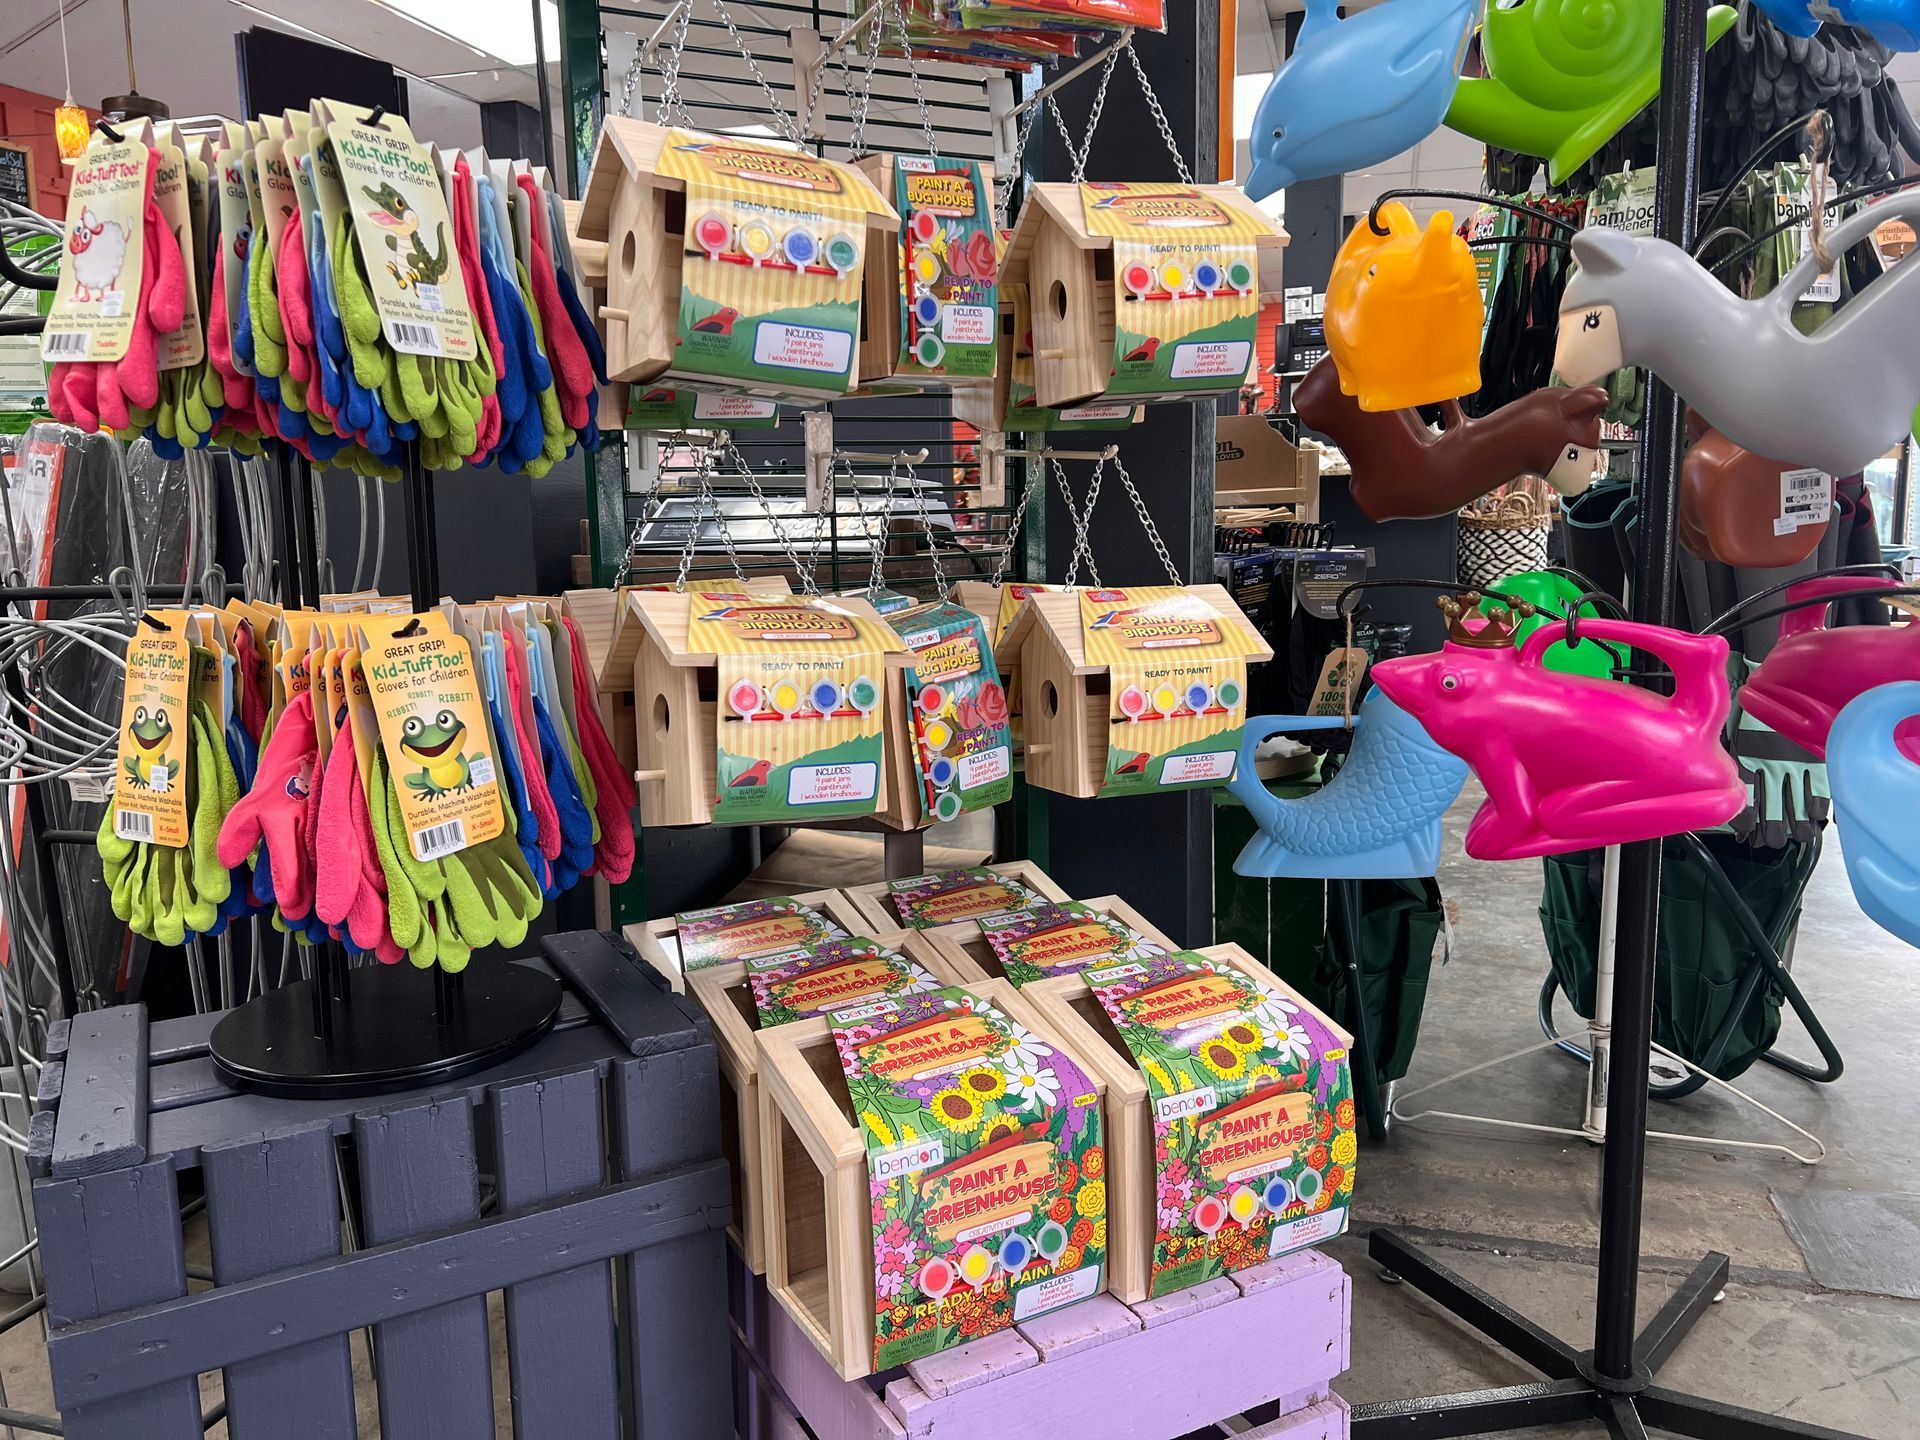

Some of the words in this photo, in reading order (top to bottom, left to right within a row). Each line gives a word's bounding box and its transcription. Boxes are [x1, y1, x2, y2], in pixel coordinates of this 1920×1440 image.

[351, 129, 382, 148] GREAT
[385, 138, 412, 154] GRIP!
[338, 139, 402, 168] Kid-Tuff
[402, 154, 430, 175] Too!
[900, 157, 934, 170] bendon
[75, 164, 118, 186] Kid-Tuff
[120, 160, 140, 178] Too!
[345, 158, 378, 177] Gloves
[380, 164, 397, 179] for
[398, 170, 438, 190] Children
[714, 157, 833, 183] BIRDHOUSE
[916, 177, 951, 192] PAINT
[953, 180, 964, 192] A
[908, 190, 933, 203] BUG
[936, 193, 974, 207] HOUSE
[1132, 200, 1176, 209] PAINT
[733, 199, 769, 213] READY
[773, 206, 786, 216] TO
[789, 209, 823, 222] PAINT!
[1126, 208, 1220, 220] BIRDHOUSE
[1150, 244, 1178, 253] READY
[1180, 244, 1192, 253] TO
[1194, 244, 1221, 253] PAINT!
[943, 276, 976, 288] READY
[979, 279, 992, 288] TO
[380, 297, 408, 309] Durable,
[953, 289, 984, 302] PAINT!
[414, 313, 435, 322] Natural
[436, 316, 455, 324] Rubber
[953, 308, 983, 317] INCLUDES:
[445, 336, 468, 347] Toddler
[702, 335, 732, 345] WARNING
[785, 328, 825, 341] INCLUDES:
[168, 343, 193, 355] Toddler
[786, 347, 824, 357] paintbrush
[790, 340, 807, 349] paint
[1197, 345, 1228, 353] INCLUDES:
[772, 355, 798, 364] wooden
[800, 356, 834, 367] birdhouse
[966, 350, 991, 358] WARNING
[748, 612, 804, 621] PAINT
[738, 621, 845, 631] BIRDHOUSE
[1123, 624, 1212, 638] BIRDHOUSE
[140, 639, 160, 651] GREAT
[162, 639, 177, 650] GRIP!
[907, 632, 938, 646] bendon
[384, 644, 415, 658] GREAT
[419, 639, 446, 653] GRIP!
[923, 646, 957, 662] PAINT
[958, 643, 969, 654] A
[130, 652, 166, 670] Kid-Tuff
[166, 654, 185, 670] Too!
[371, 654, 435, 681] Kid-Tuff
[436, 651, 464, 669] Too!
[761, 662, 794, 671] READY
[798, 662, 810, 670] TO
[813, 661, 844, 670] PAINT!
[915, 662, 941, 676] BUG
[944, 653, 980, 670] HOUSE
[128, 668, 147, 680] Gloves
[148, 669, 158, 679] for
[160, 669, 184, 683] Children
[1145, 667, 1170, 678] READY
[1173, 668, 1184, 676] TO
[1186, 666, 1212, 675] PAINT!
[377, 678, 409, 694] Gloves
[411, 675, 426, 686] for
[429, 667, 469, 683] Children
[128, 692, 147, 703] RIBBIT!
[160, 692, 182, 709] RIBBIT!
[407, 690, 434, 699] RIBBIT!
[387, 702, 418, 719] RIBBIT!
[439, 692, 474, 704] RIBBIT!
[956, 728, 988, 742] READY
[992, 722, 1004, 732] TO
[966, 737, 998, 752] PAINT!
[968, 751, 998, 765] INCLUDES:
[1185, 755, 1215, 763] INCLUDES:
[816, 767, 852, 776] INCLUDES:
[817, 784, 851, 792] paintbrush
[138, 794, 157, 802] Machine
[159, 797, 182, 806] Washable
[408, 808, 436, 820] Durable,
[438, 798, 465, 811] Machine
[467, 788, 496, 802] Washable
[412, 819, 429, 829] Nylon
[443, 810, 463, 820] Natural
[464, 803, 483, 812] Rubber
[484, 799, 496, 807] Palm
[159, 825, 179, 833] X-Small
[471, 819, 494, 831] X-Small
[919, 896, 1017, 919] GREENHOUSE
[931, 894, 973, 908] PAINT
[985, 913, 1033, 926] bendon
[718, 928, 766, 942] PAINT
[1031, 936, 1075, 950] PAINT
[1078, 932, 1092, 941] A
[1019, 936, 1122, 963] GREENHOUSE
[754, 951, 807, 966] bendon
[795, 973, 848, 991] PAINT
[854, 968, 868, 979] A
[1091, 965, 1144, 982] bendon
[779, 971, 901, 1008] GREENHOUSE
[1144, 989, 1196, 1008] PAINT
[1198, 985, 1215, 997] A
[838, 1002, 895, 1020] bendon
[1136, 988, 1248, 1025] GREENHOUSE
[886, 1032, 943, 1056] PAINT
[949, 1027, 968, 1039] A
[870, 1031, 1001, 1075] GREENHOUSE
[1325, 1051, 1335, 1060] Ages
[1074, 1097, 1088, 1106] Ages
[1161, 1092, 1213, 1116] bendon
[1221, 1112, 1274, 1139] PAINT
[1277, 1107, 1290, 1124] A
[1199, 1122, 1314, 1168] GREENHOUSE
[879, 1148, 940, 1177] bendon
[949, 1164, 1009, 1197] PAINT
[1014, 1158, 1029, 1176] A
[924, 1174, 1056, 1228] GREENHOUSE
[1173, 1261, 1203, 1277] WARNING
[1040, 1275, 1074, 1291] INCLUDES:
[915, 1294, 973, 1319] READY
[899, 1329, 936, 1348] WARNING
